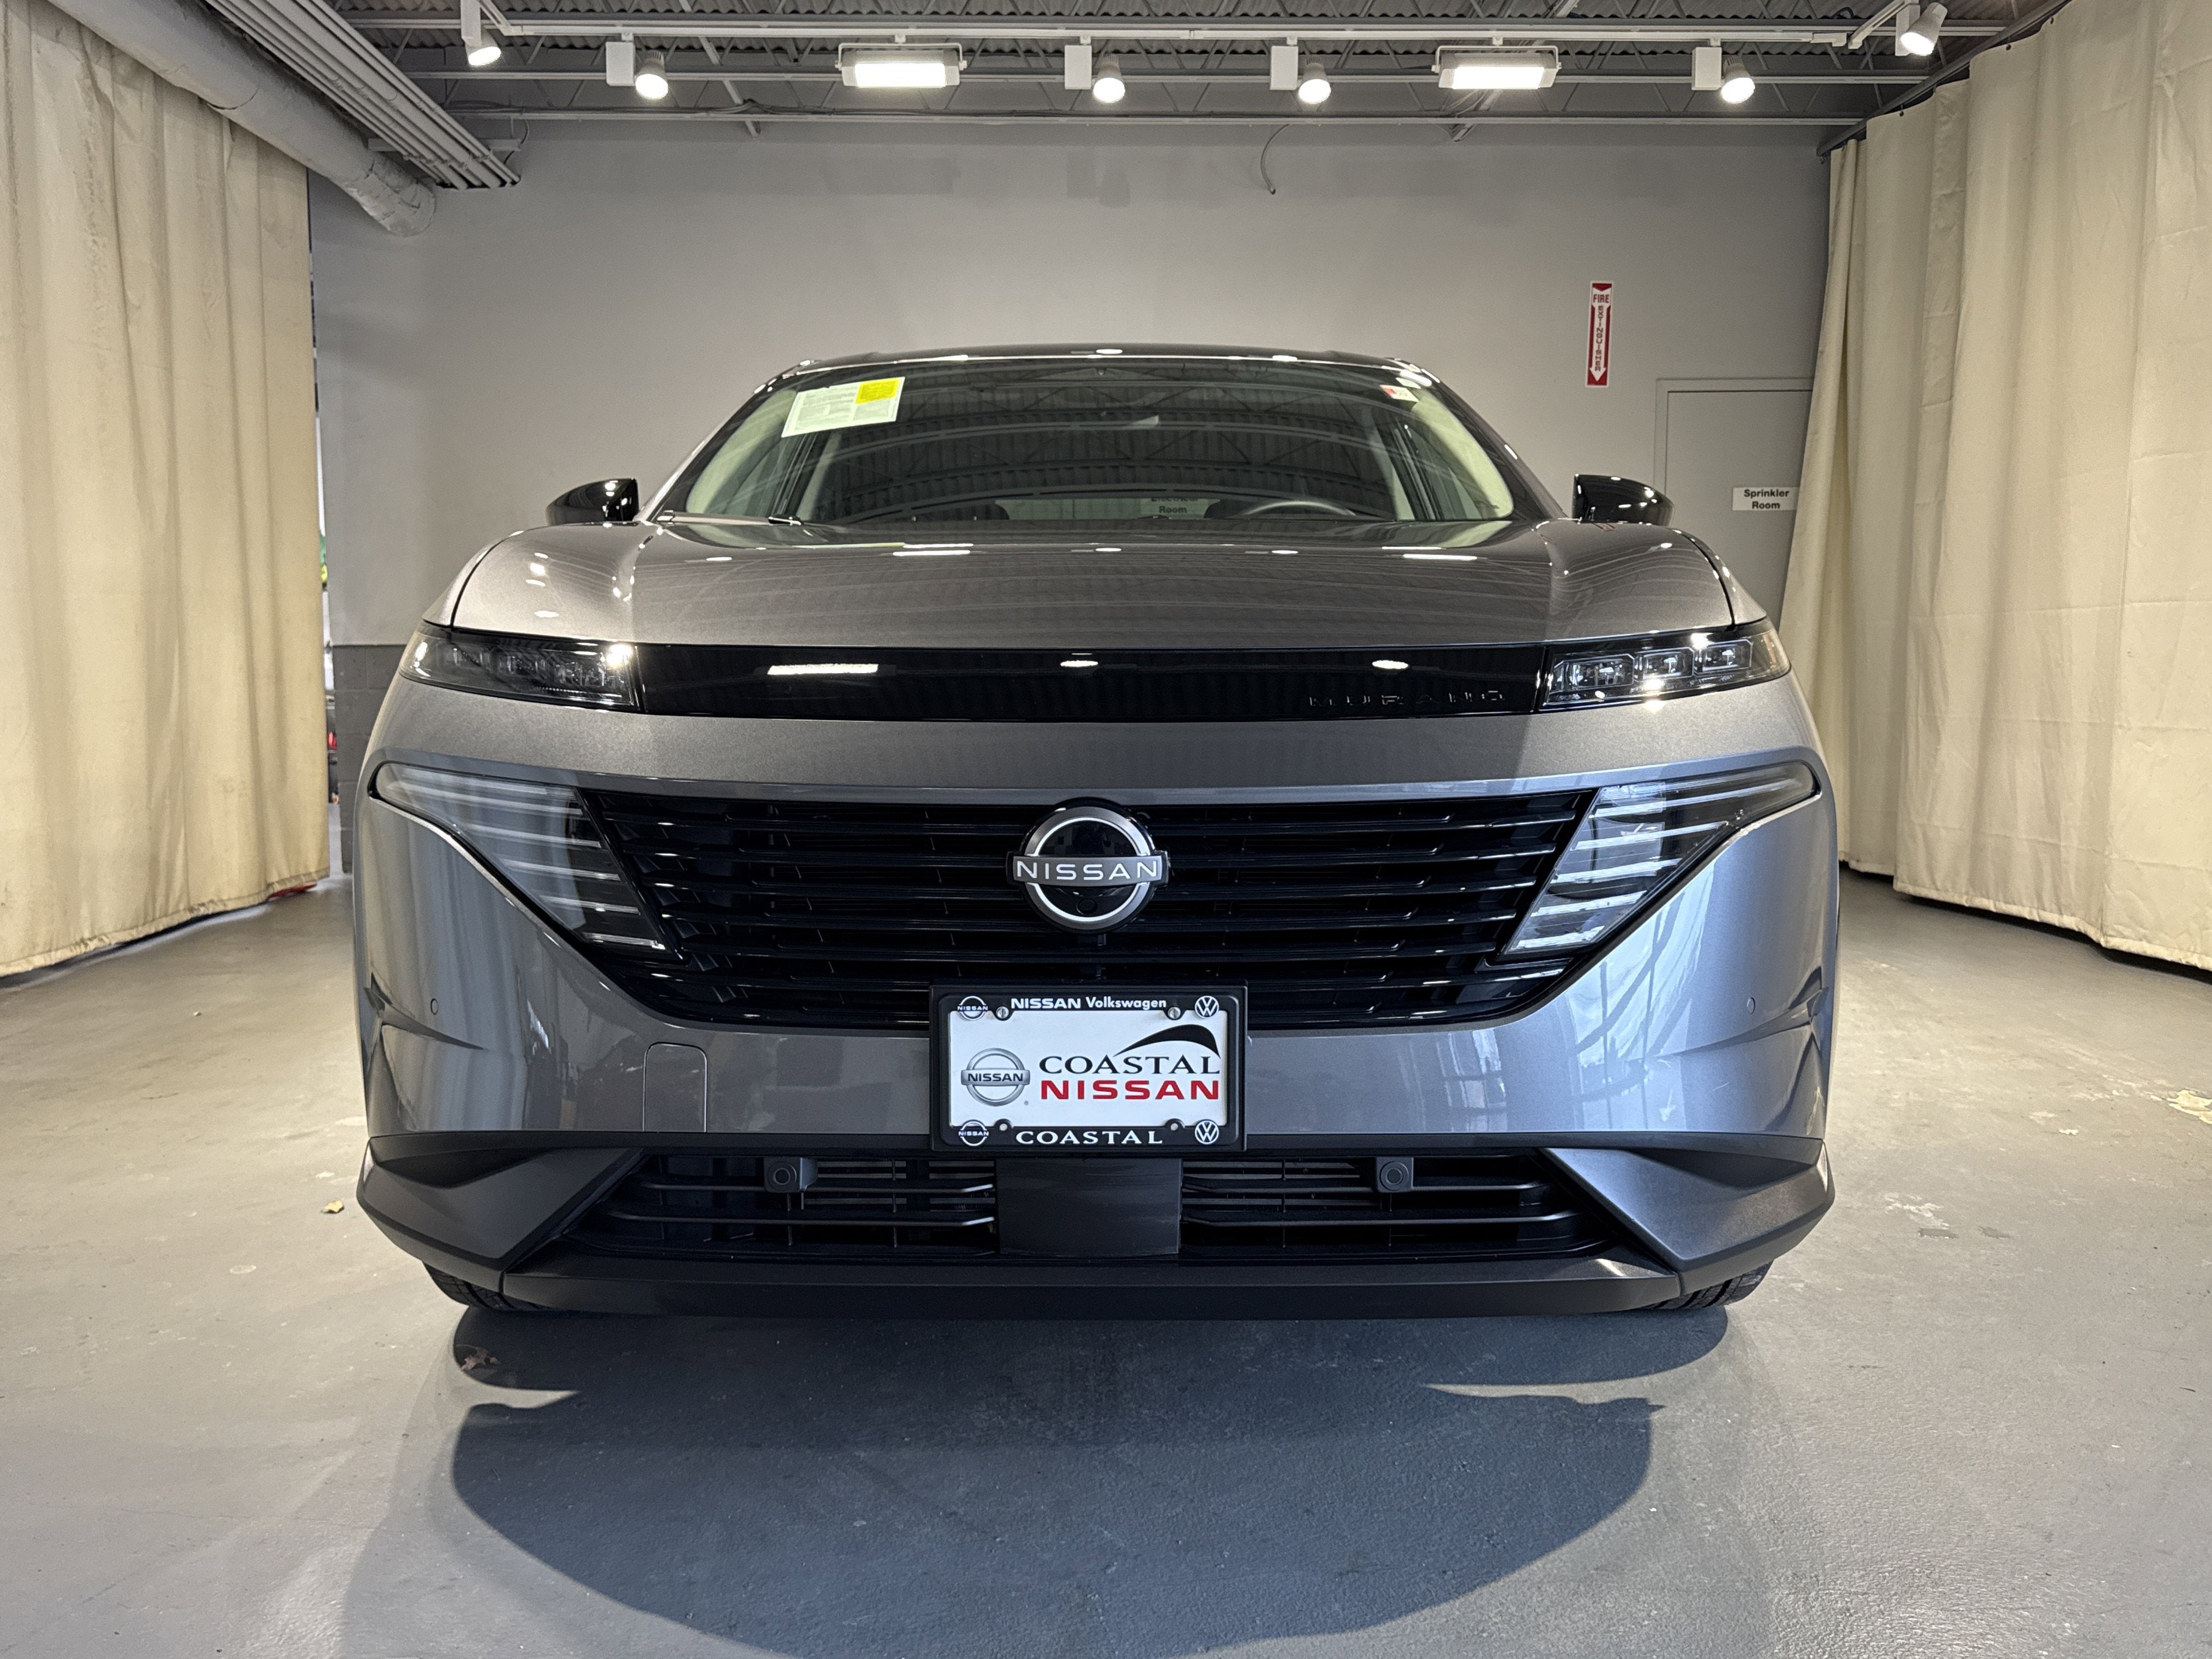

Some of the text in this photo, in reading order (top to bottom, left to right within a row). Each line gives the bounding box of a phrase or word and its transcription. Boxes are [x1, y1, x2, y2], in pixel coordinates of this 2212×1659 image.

[1593, 294, 1609, 303] FIRE
[1595, 306, 1604, 371] EXTINGUISHER
[1743, 489, 1790, 499] Sprinkler
[1017, 861, 1157, 880] NISSAN
[1011, 996, 1166, 1010] NISSAN Volkswagen
[1039, 1054, 1220, 1074] COASTAL
[968, 1073, 1023, 1081] NISSAN
[1041, 1080, 1218, 1100] NISSAN
[1015, 1130, 1163, 1144] COASTAL
